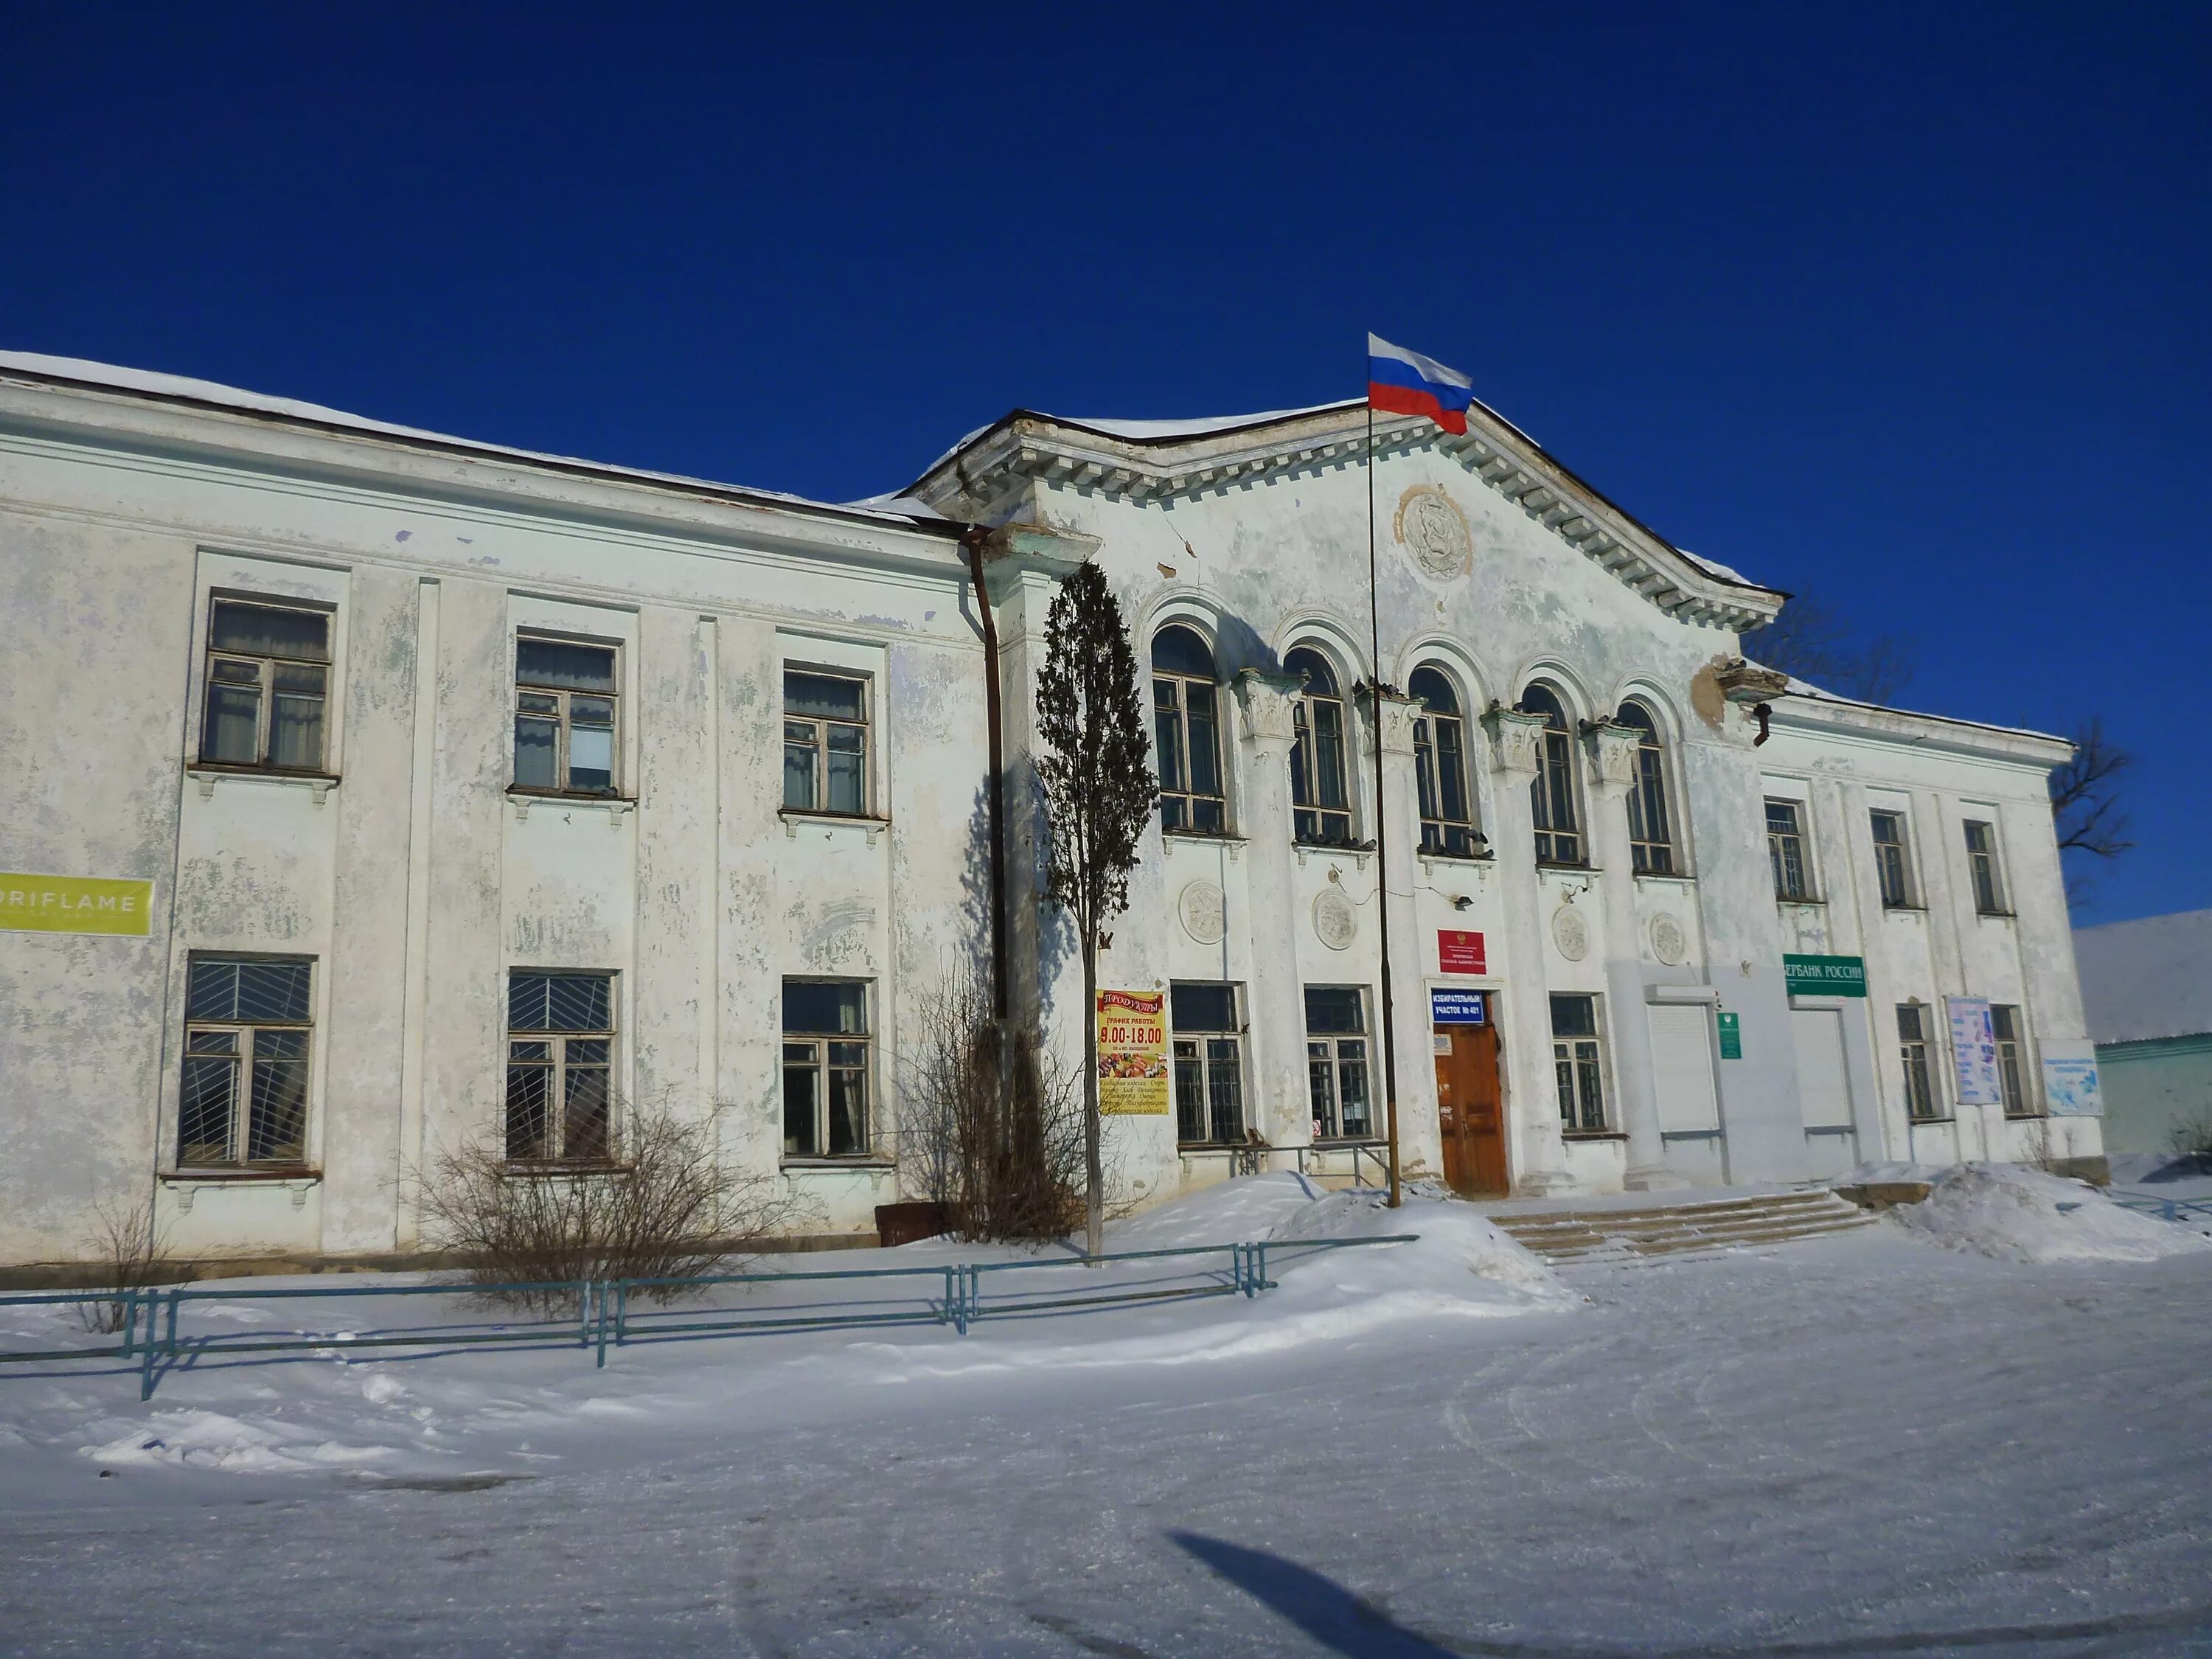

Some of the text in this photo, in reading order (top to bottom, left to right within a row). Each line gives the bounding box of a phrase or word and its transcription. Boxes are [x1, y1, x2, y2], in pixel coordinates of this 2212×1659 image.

[0, 889, 135, 912] RIFLAME
[1784, 964, 1863, 978] ЕРБАНК РОССИИ
[1104, 993, 1158, 1013] ПРОДУКТЫ
[1433, 994, 1481, 1003] ИЗБИРАТЕЛЬНЫЙ
[1435, 1006, 1461, 1015] УЧАСТОК
[1100, 1026, 1161, 1044] 9.00-18.00
